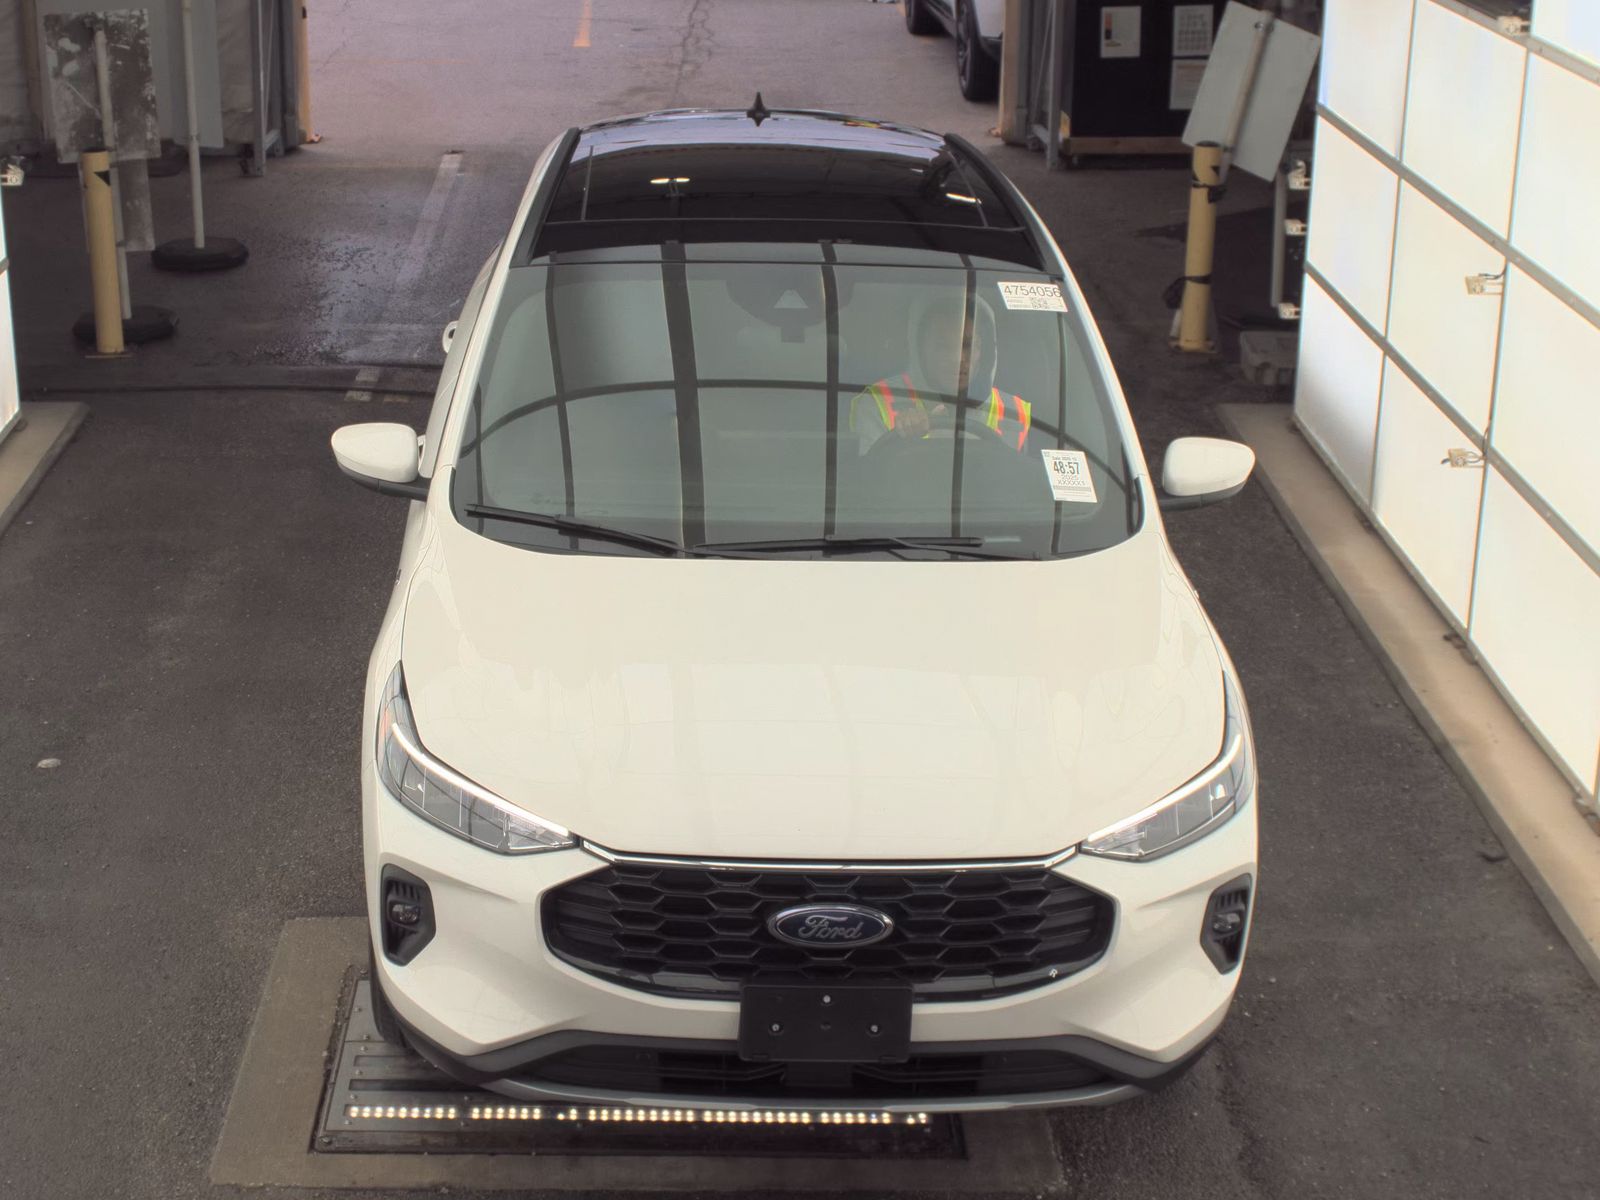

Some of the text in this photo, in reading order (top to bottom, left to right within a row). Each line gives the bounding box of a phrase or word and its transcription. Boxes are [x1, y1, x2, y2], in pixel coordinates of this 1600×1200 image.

[1004, 285, 1062, 297] 4754056
[1053, 461, 1080, 474] 48:57
[798, 914, 864, 939] Ford
